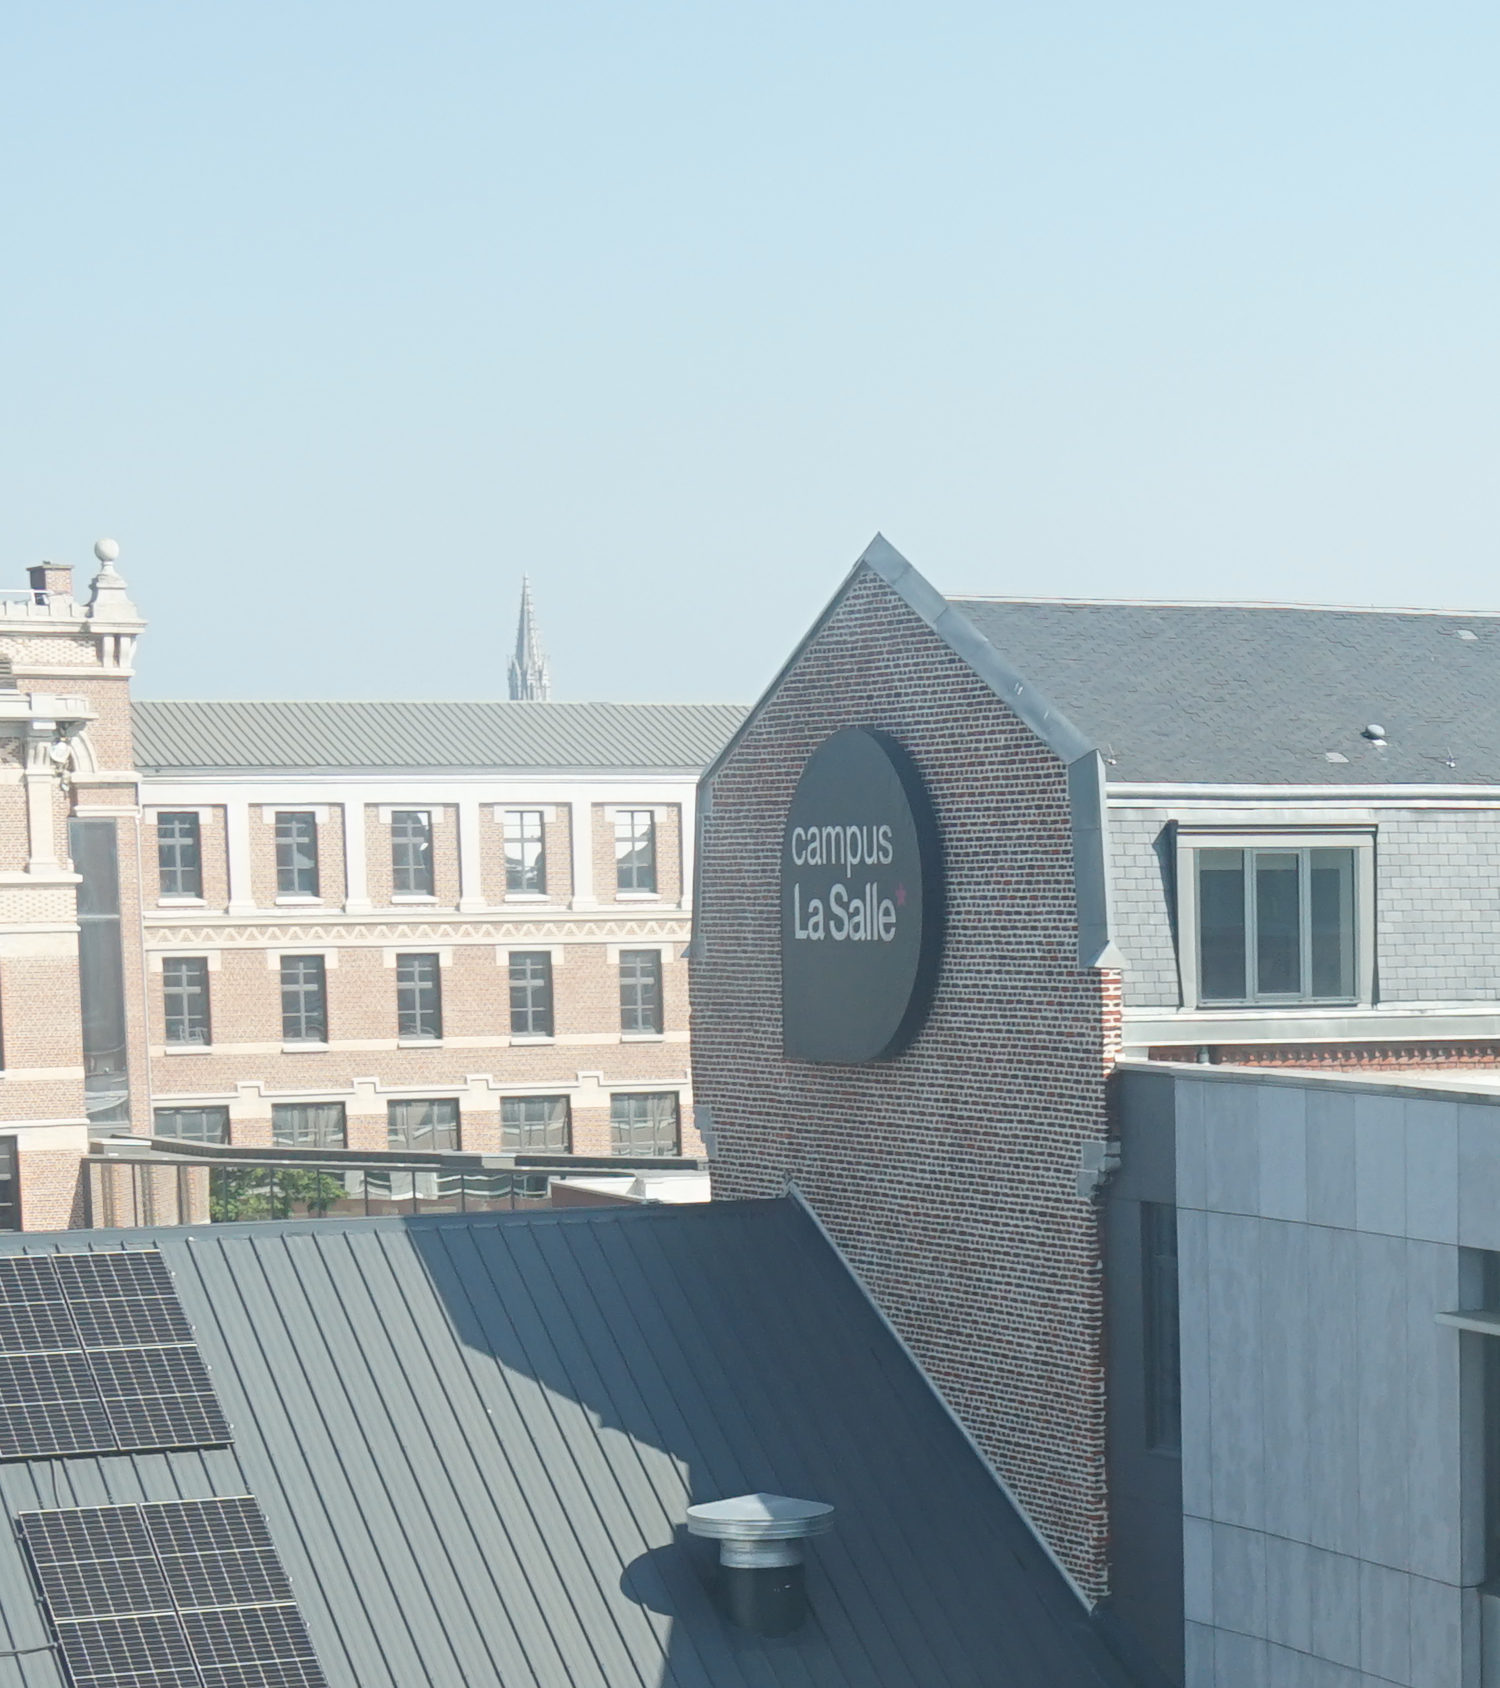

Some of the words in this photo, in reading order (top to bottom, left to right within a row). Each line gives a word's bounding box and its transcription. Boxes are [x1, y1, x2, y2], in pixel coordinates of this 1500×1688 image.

[792, 825, 893, 878] campus
[794, 883, 825, 940] La
[829, 882, 896, 941] Salle
